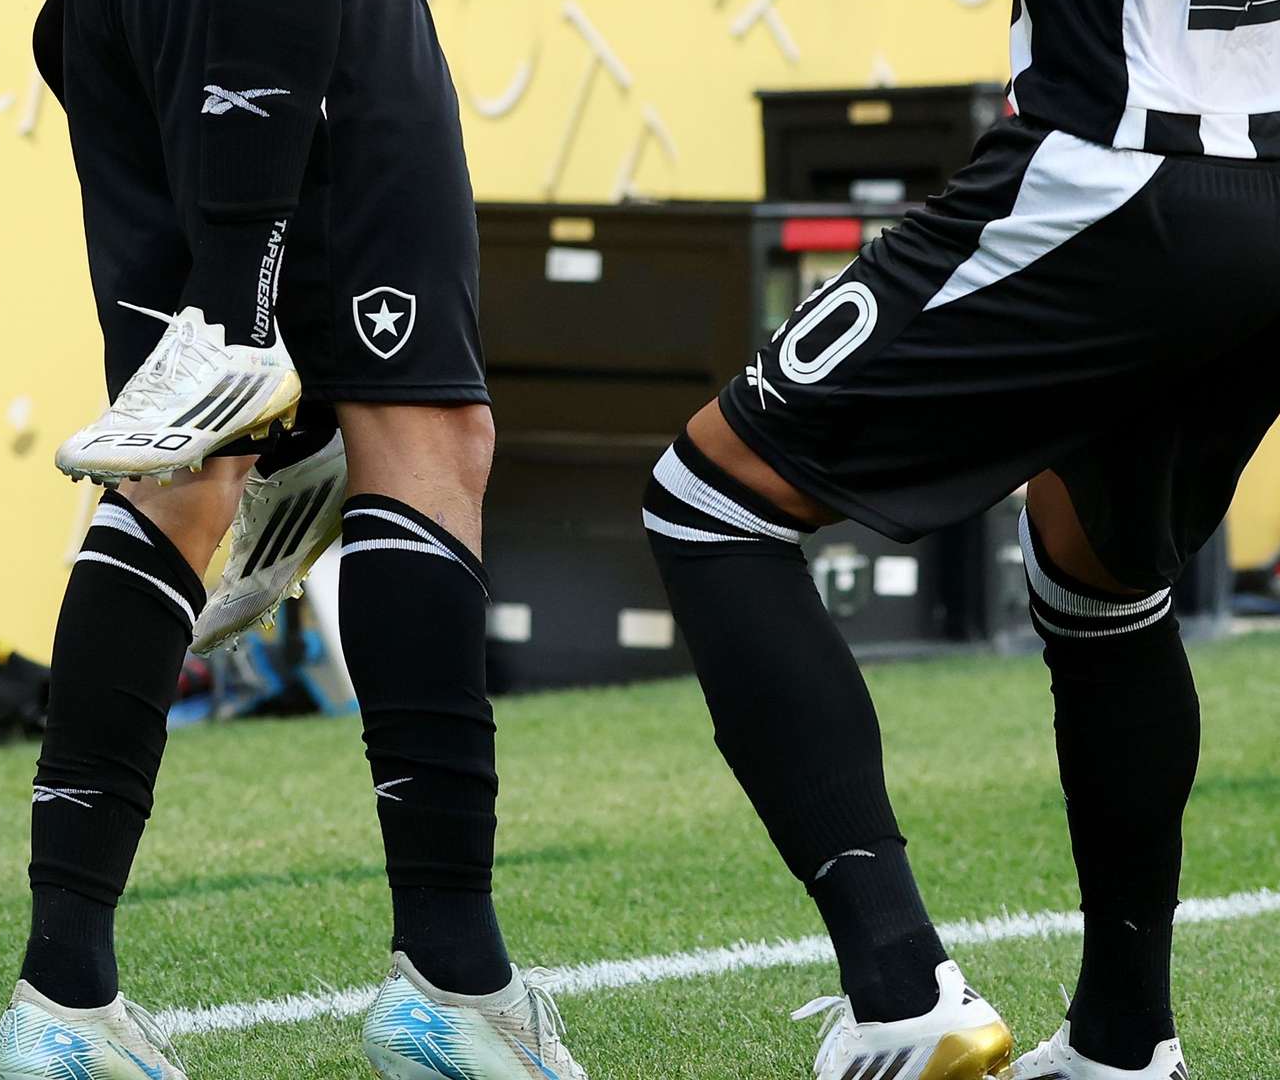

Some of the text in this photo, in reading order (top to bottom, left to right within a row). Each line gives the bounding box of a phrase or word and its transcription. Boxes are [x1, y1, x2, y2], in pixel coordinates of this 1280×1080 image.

[250, 219, 287, 345] TAPEDESIGN
[770, 255, 879, 385] 0
[81, 432, 193, 452] F50
